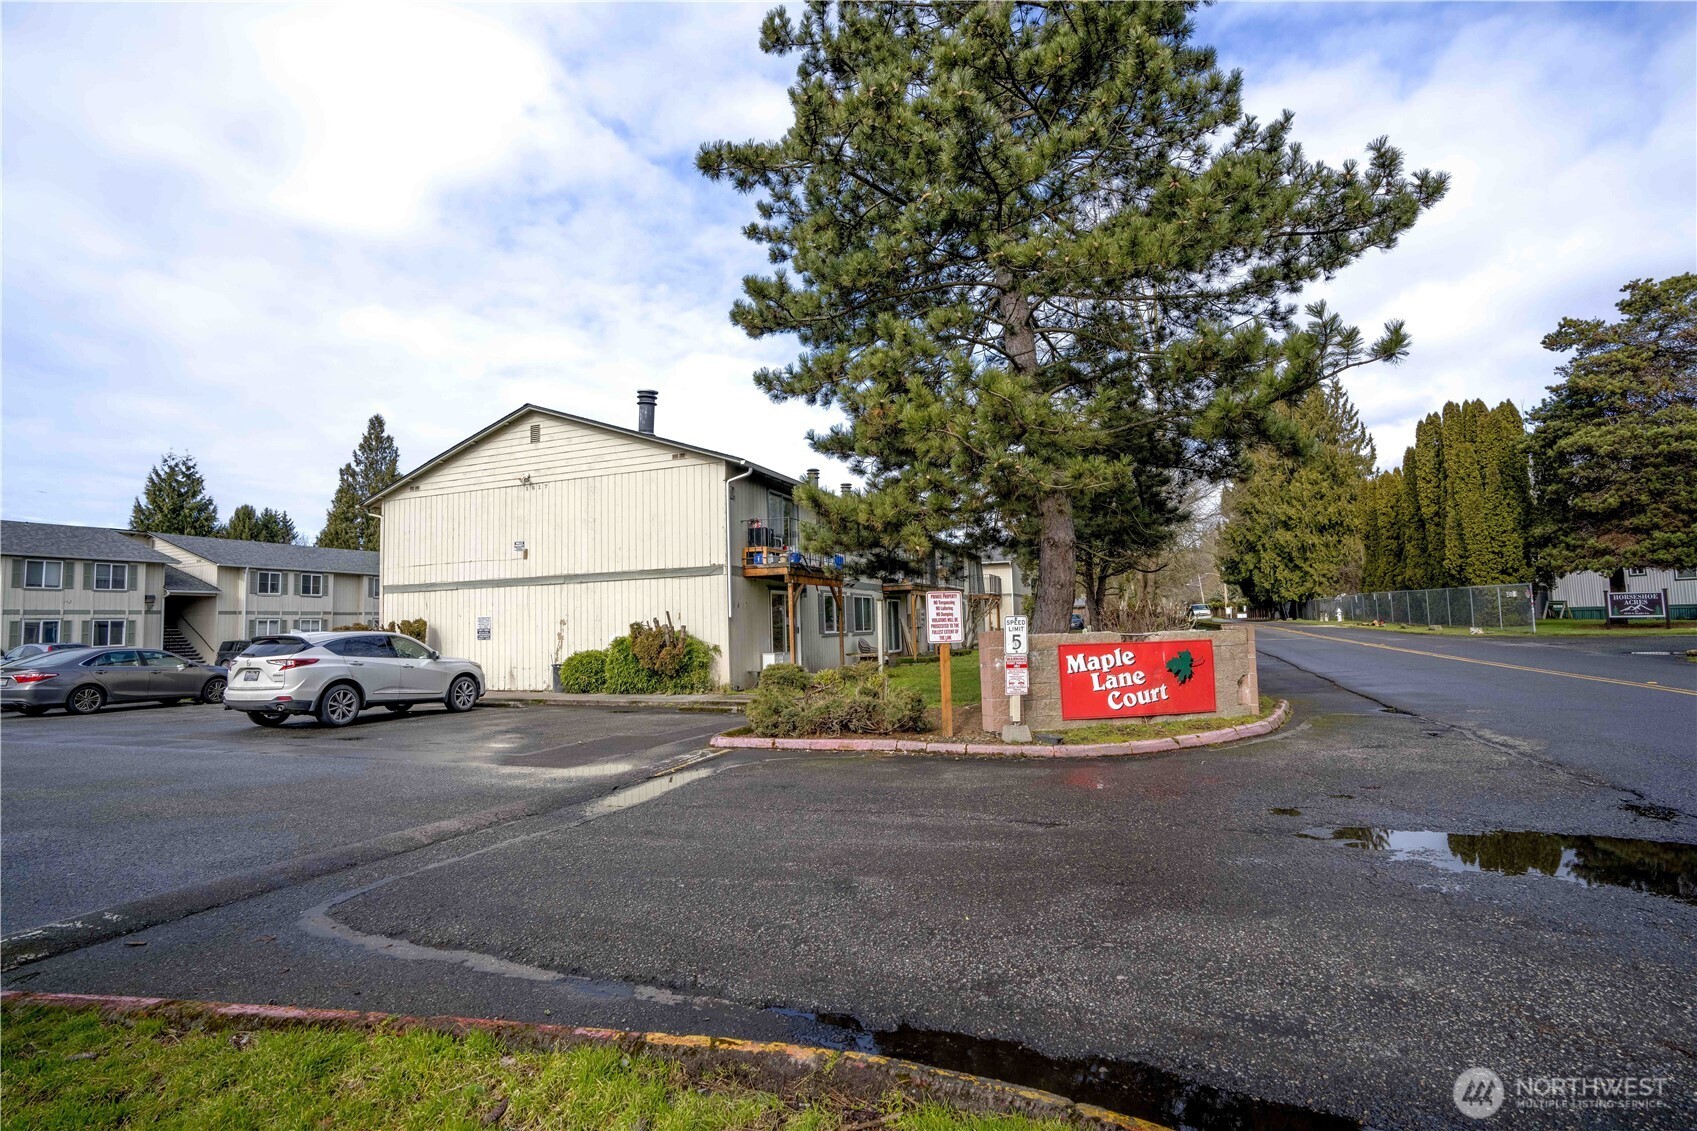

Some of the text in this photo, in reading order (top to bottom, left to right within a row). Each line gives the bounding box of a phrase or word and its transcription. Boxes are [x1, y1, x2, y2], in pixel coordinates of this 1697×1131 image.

[1012, 634, 1022, 650] 5
[1066, 648, 1136, 674] Maple
[1090, 670, 1146, 692] Lane
[1108, 684, 1168, 710] Court
